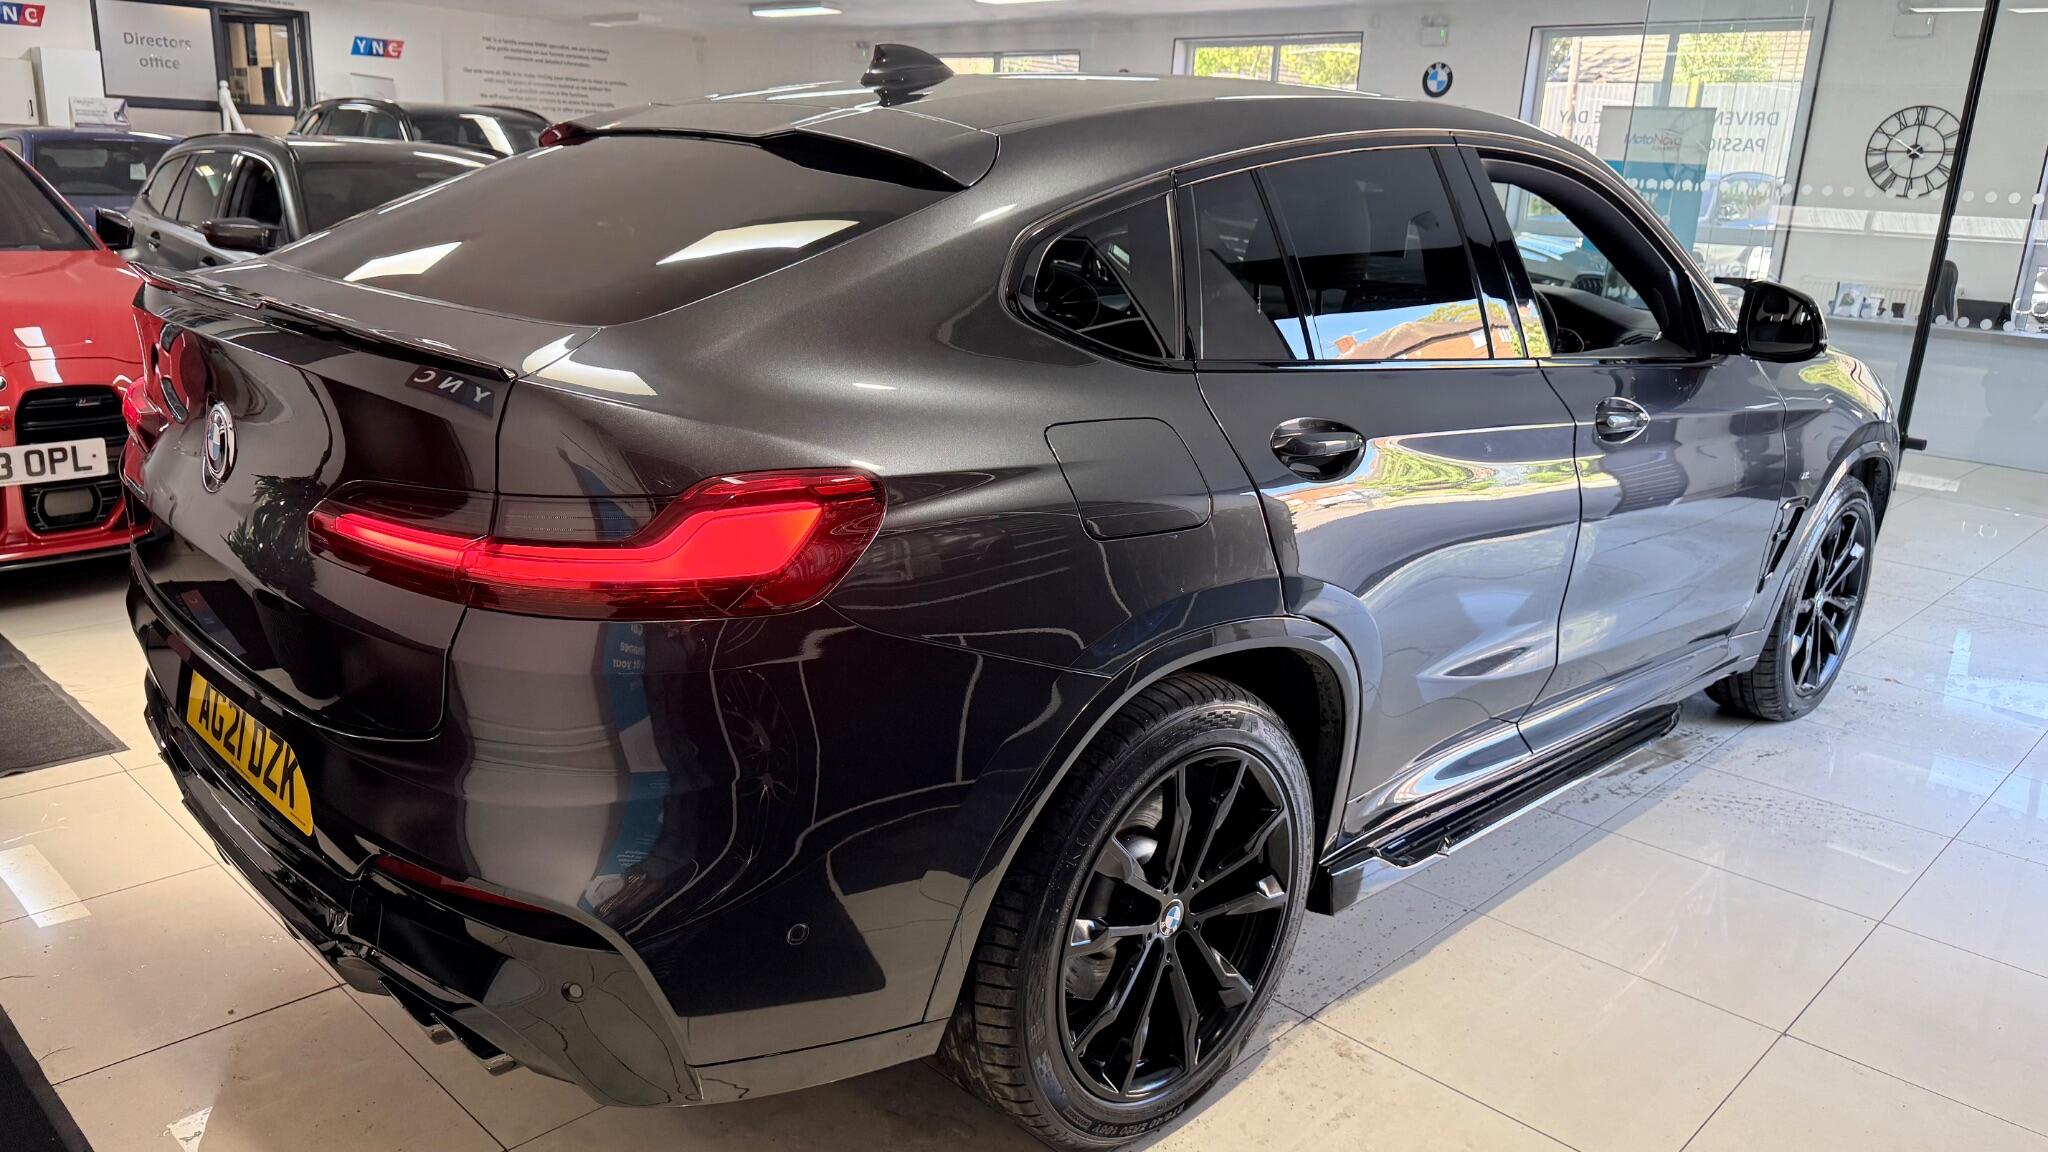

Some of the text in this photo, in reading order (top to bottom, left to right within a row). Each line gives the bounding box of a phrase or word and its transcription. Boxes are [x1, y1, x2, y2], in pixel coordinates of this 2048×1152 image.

[123, 31, 192, 50] Directors
[356, 38, 398, 57] YNC
[139, 55, 181, 71] office
[24, 444, 93, 478] OPL
[199, 681, 300, 811] AG21 DZK
